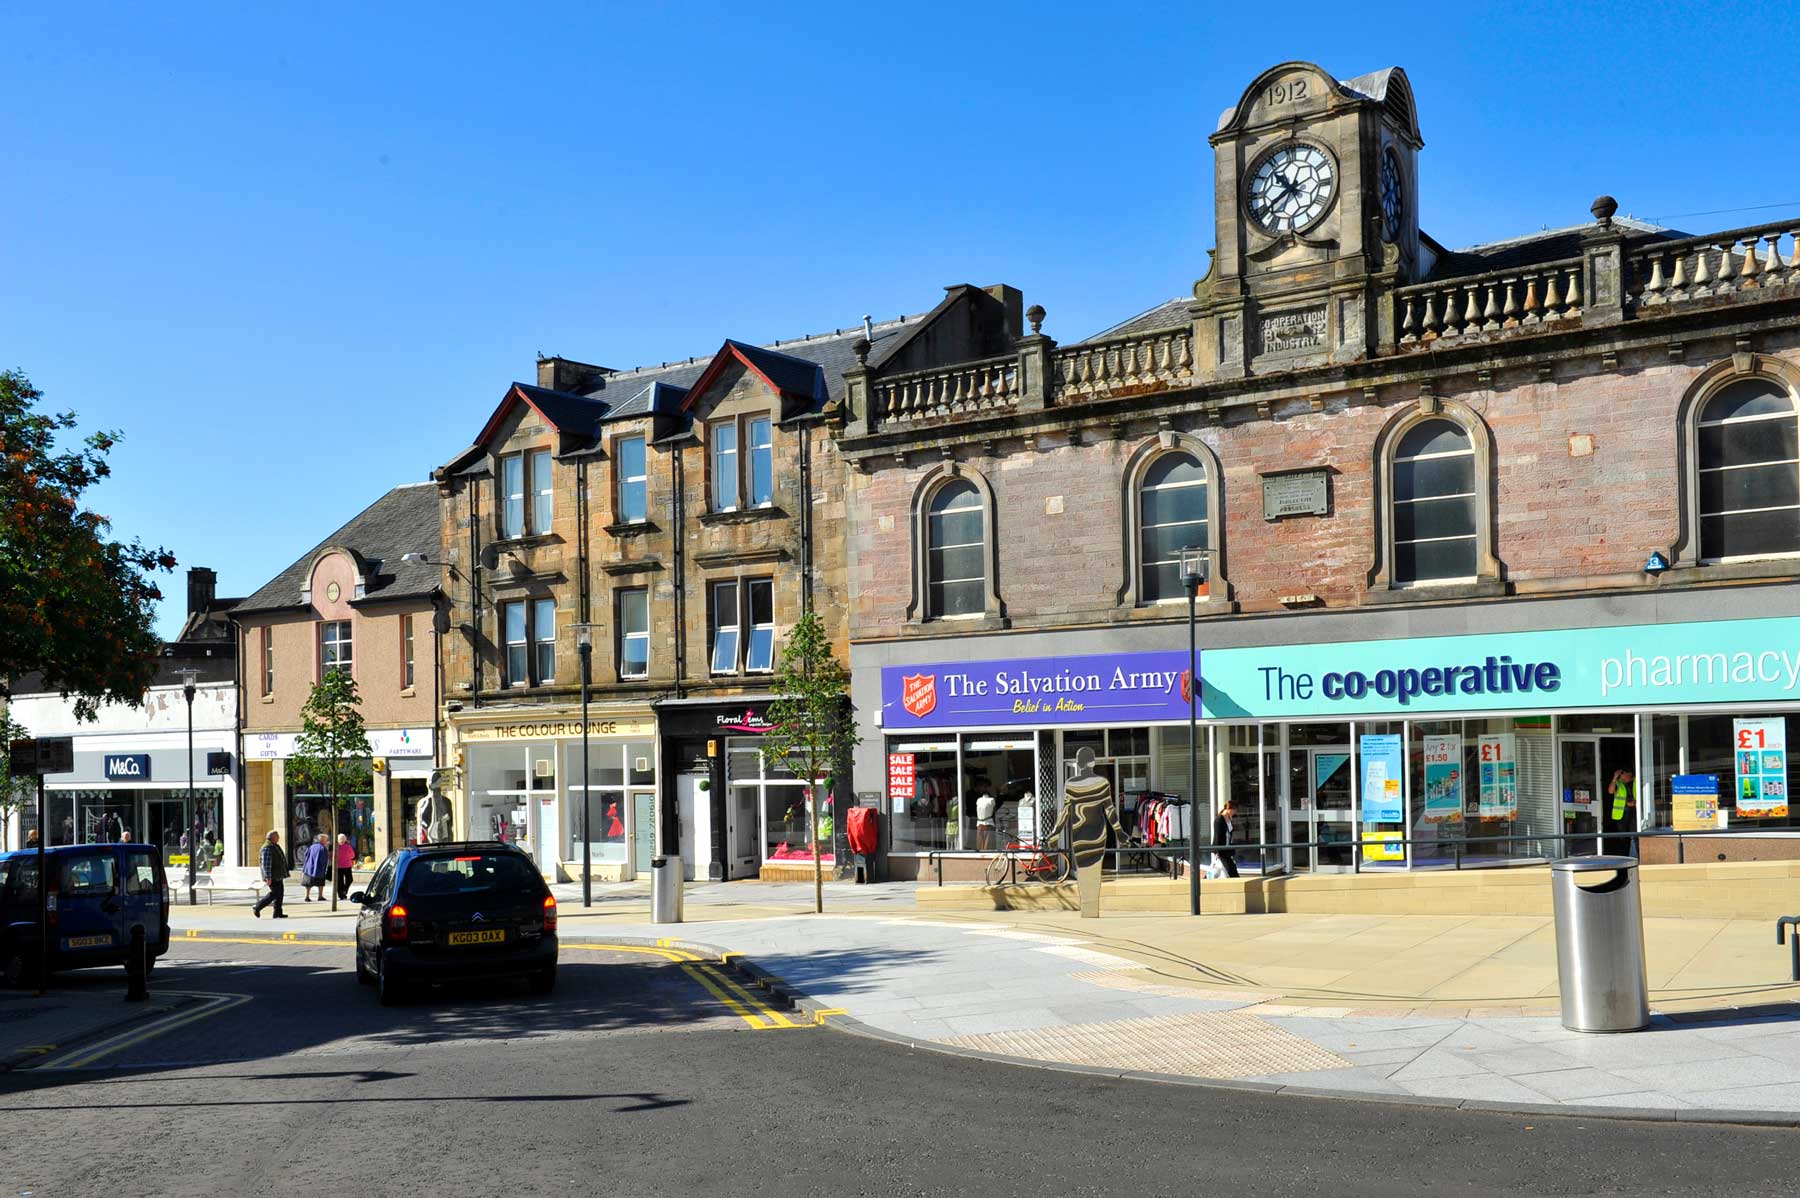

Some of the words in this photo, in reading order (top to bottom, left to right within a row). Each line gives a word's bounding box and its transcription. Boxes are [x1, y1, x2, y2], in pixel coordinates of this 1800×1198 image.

[1268, 79, 1307, 106] 1912
[944, 674, 988, 697] The
[996, 669, 1101, 696] Salvation
[1109, 665, 1178, 694] Army
[1257, 666, 1313, 701] The
[1322, 655, 1561, 705] co-operative
[1601, 648, 1800, 696] pharmacy
[909, 679, 922, 692] THE
[905, 681, 935, 706] SALVATION
[915, 692, 933, 712] ARMY
[1012, 698, 1041, 714] Belief
[1043, 702, 1053, 713] in
[1055, 697, 1085, 713] Action
[716, 715, 743, 725] Floral
[494, 725, 516, 738] THE
[519, 723, 566, 737] COLOUR
[569, 721, 617, 735] LOUNGE
[258, 733, 279, 741] CARDS
[1738, 728, 1765, 749] £1
[1440, 742, 1446, 751] 2
[1481, 743, 1501, 762] £1
[889, 755, 912, 765] SALE
[1425, 753, 1448, 762] £1.50
[889, 766, 912, 775] SALE
[889, 776, 912, 785] SALE
[889, 787, 912, 796] SALE
[452, 931, 479, 943] KG03
